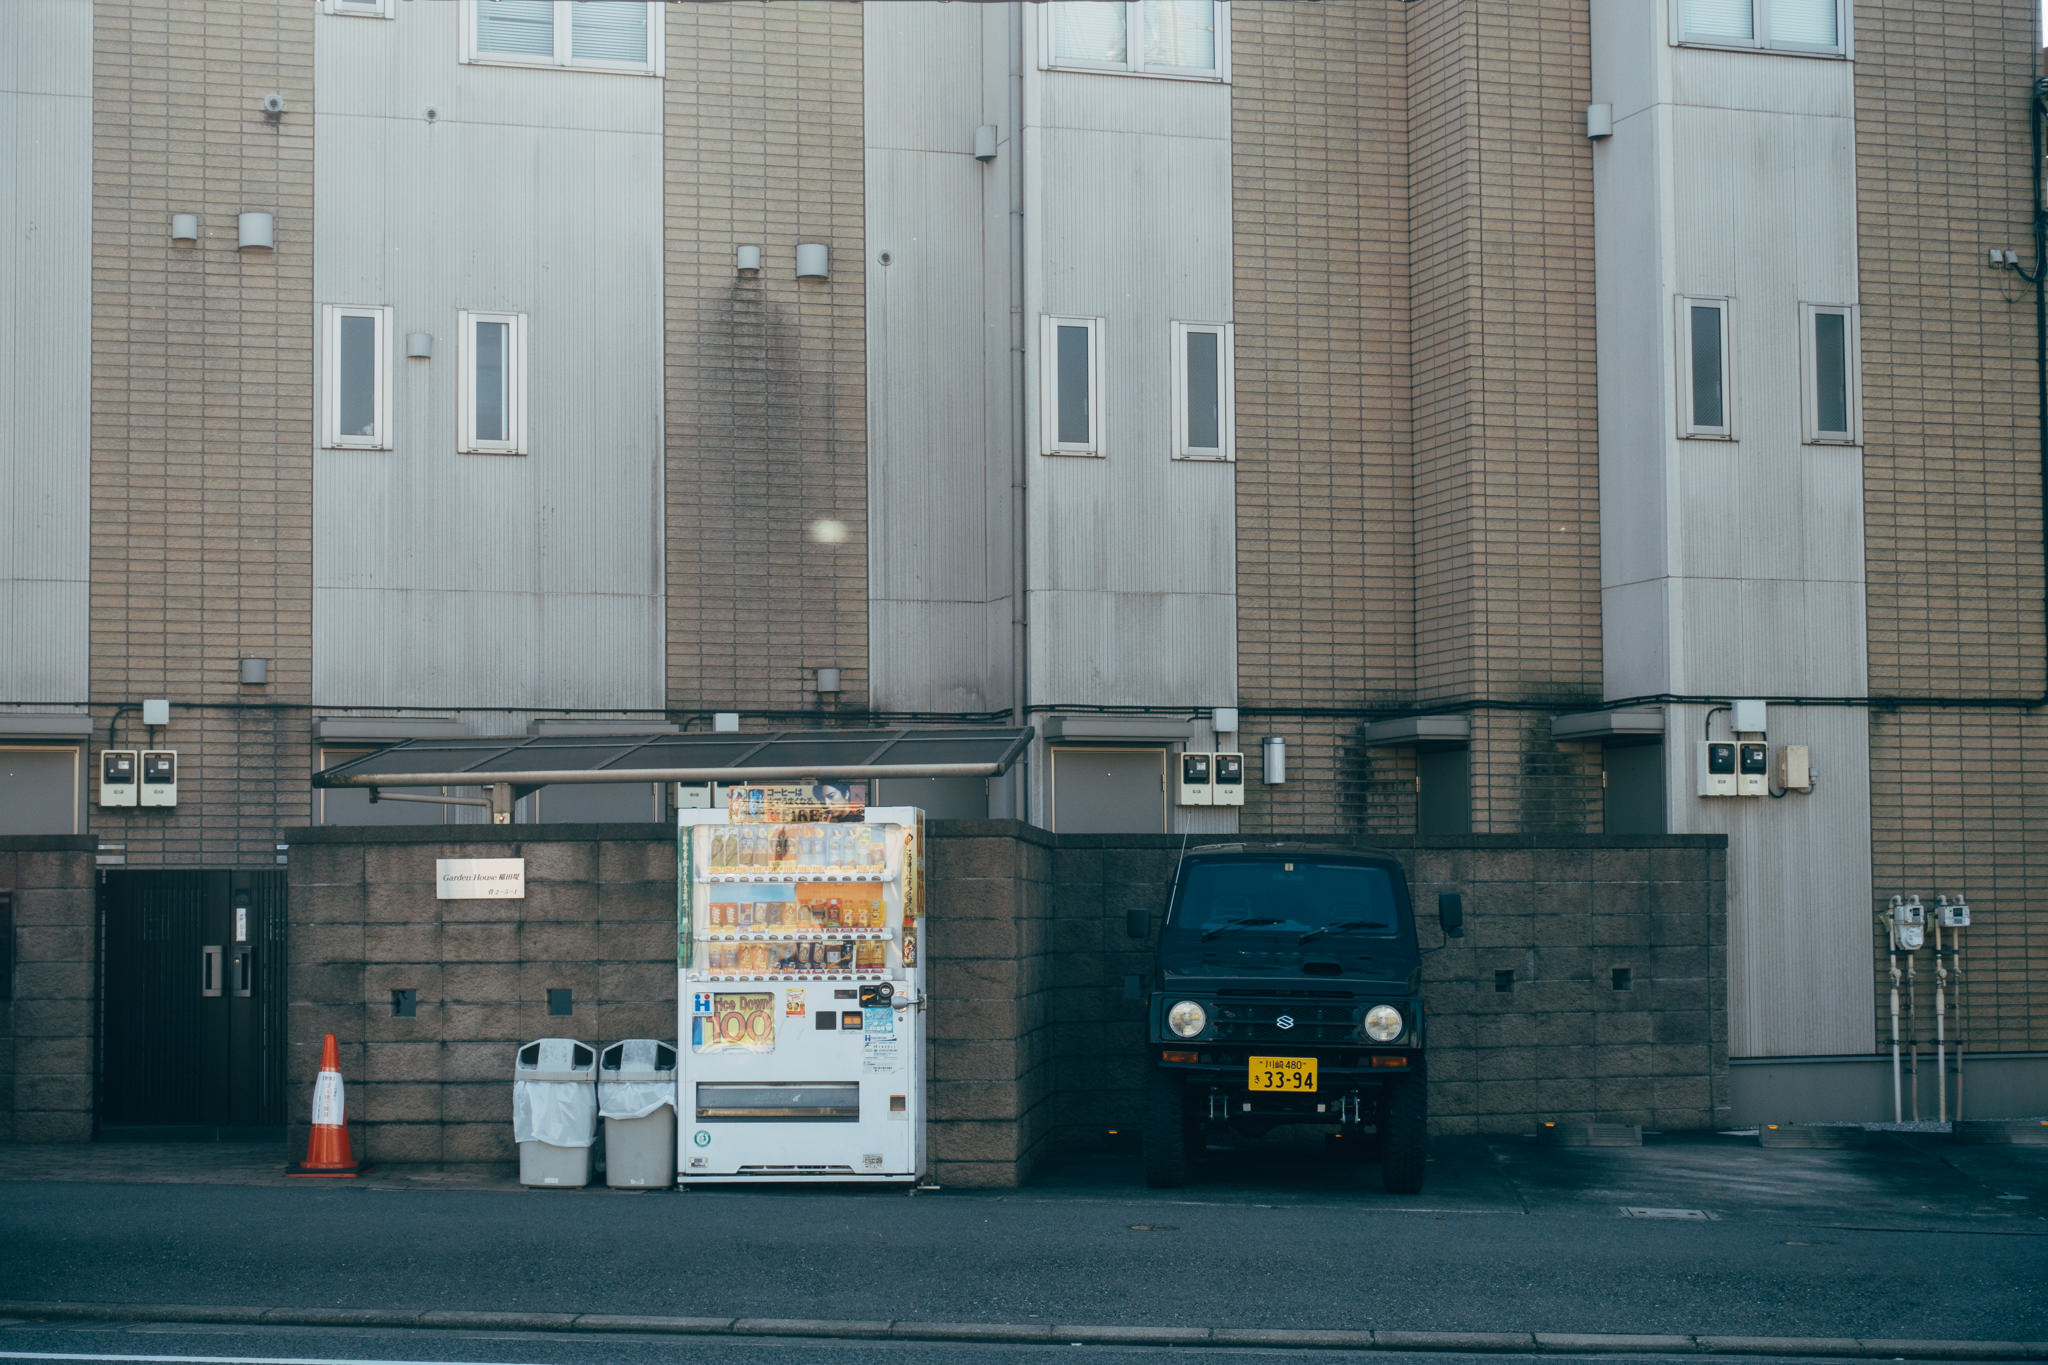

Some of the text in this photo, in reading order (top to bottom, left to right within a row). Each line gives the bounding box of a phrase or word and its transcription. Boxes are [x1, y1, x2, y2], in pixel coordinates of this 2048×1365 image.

[767, 788, 803, 797] コーヒーは
[443, 873, 472, 881] Garden
[473, 873, 497, 881] House
[714, 996, 736, 1012] rice
[1264, 1071, 1313, 1089] 33-94
